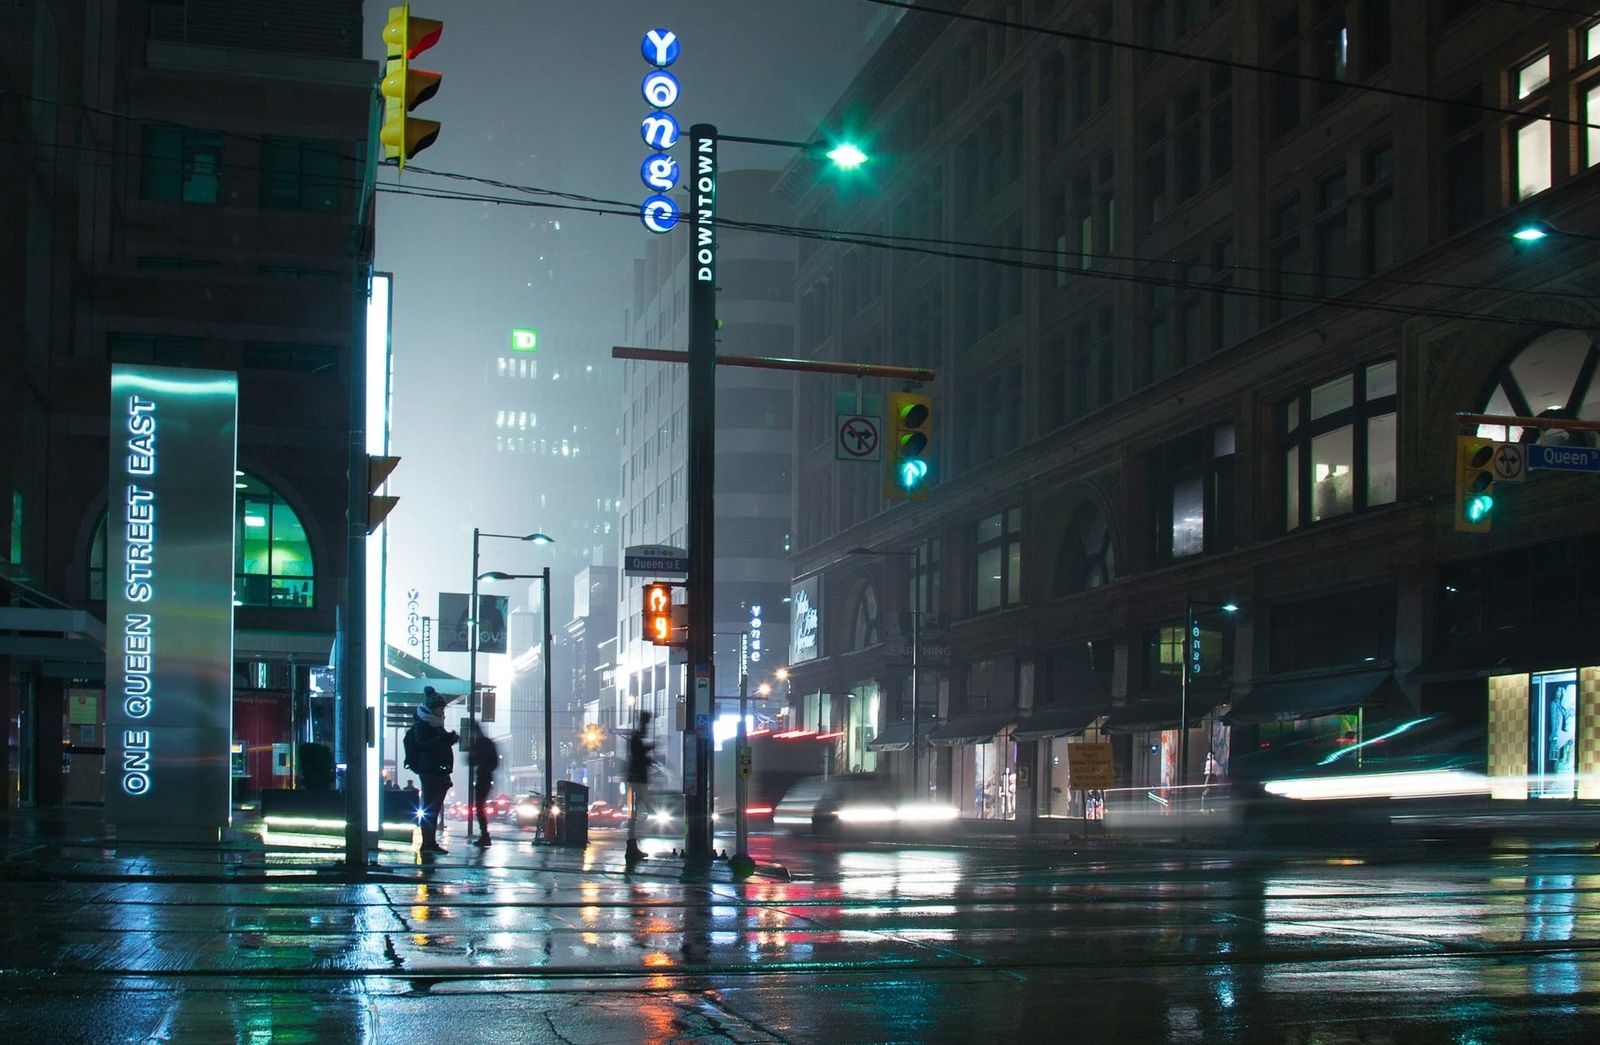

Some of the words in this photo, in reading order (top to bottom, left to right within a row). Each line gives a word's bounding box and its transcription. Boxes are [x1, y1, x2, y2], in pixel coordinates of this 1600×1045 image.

[642, 29, 678, 232] Yonge
[698, 138, 713, 281] DOWNTOWN
[512, 331, 536, 348] TD
[128, 395, 155, 475] EAST
[1543, 447, 1588, 465] Queen
[127, 484, 154, 602] STREET
[633, 558, 664, 569] Queen
[675, 559, 681, 570] E
[125, 613, 152, 719] QUEEN
[123, 730, 150, 795] ONE
